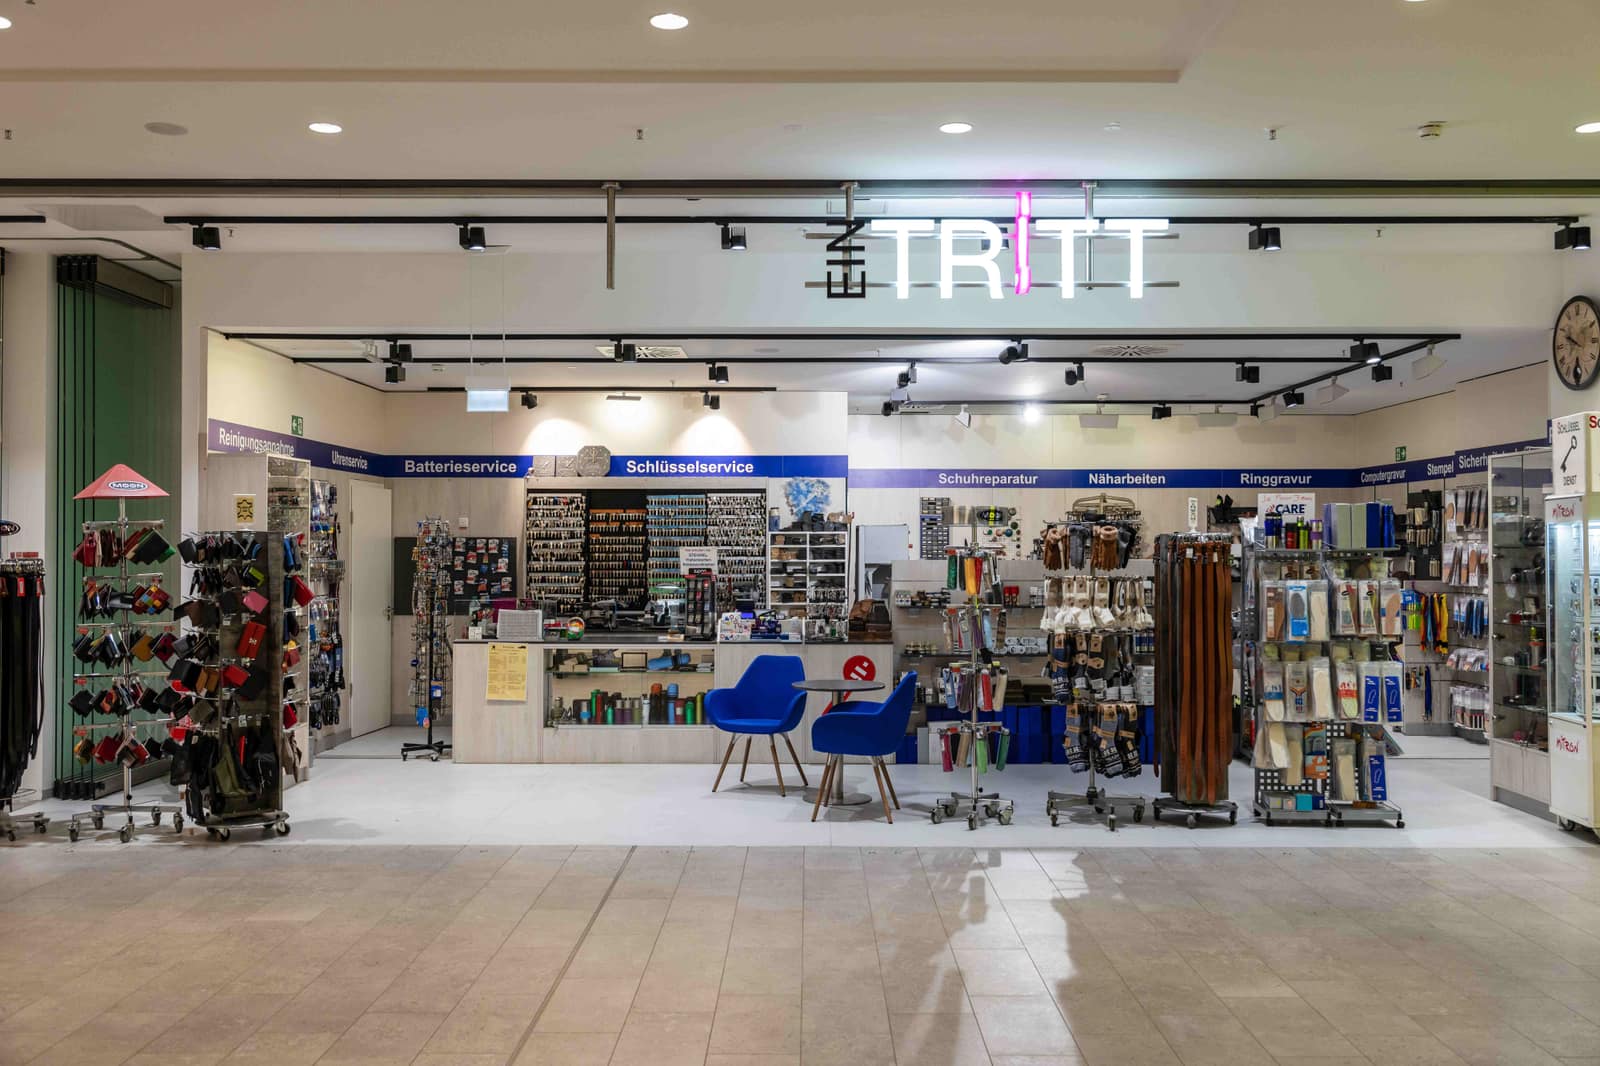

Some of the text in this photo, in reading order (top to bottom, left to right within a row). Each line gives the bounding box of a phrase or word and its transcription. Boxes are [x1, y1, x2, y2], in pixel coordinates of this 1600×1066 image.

[826, 191, 1170, 299] EIN TRITT
[219, 427, 295, 457] Reinigungsannahme
[331, 449, 368, 470] Uhrenservice
[404, 459, 517, 474] Batterieservice
[626, 459, 755, 474] Schlüsselservice
[1427, 459, 1454, 477] Stempel
[938, 472, 1038, 487] Schuhreparatur
[1089, 472, 1166, 485] Näharbeiten
[1240, 473, 1312, 487] Ringgravur
[1361, 469, 1406, 484] Computergravur
[1275, 503, 1306, 515] CARE
